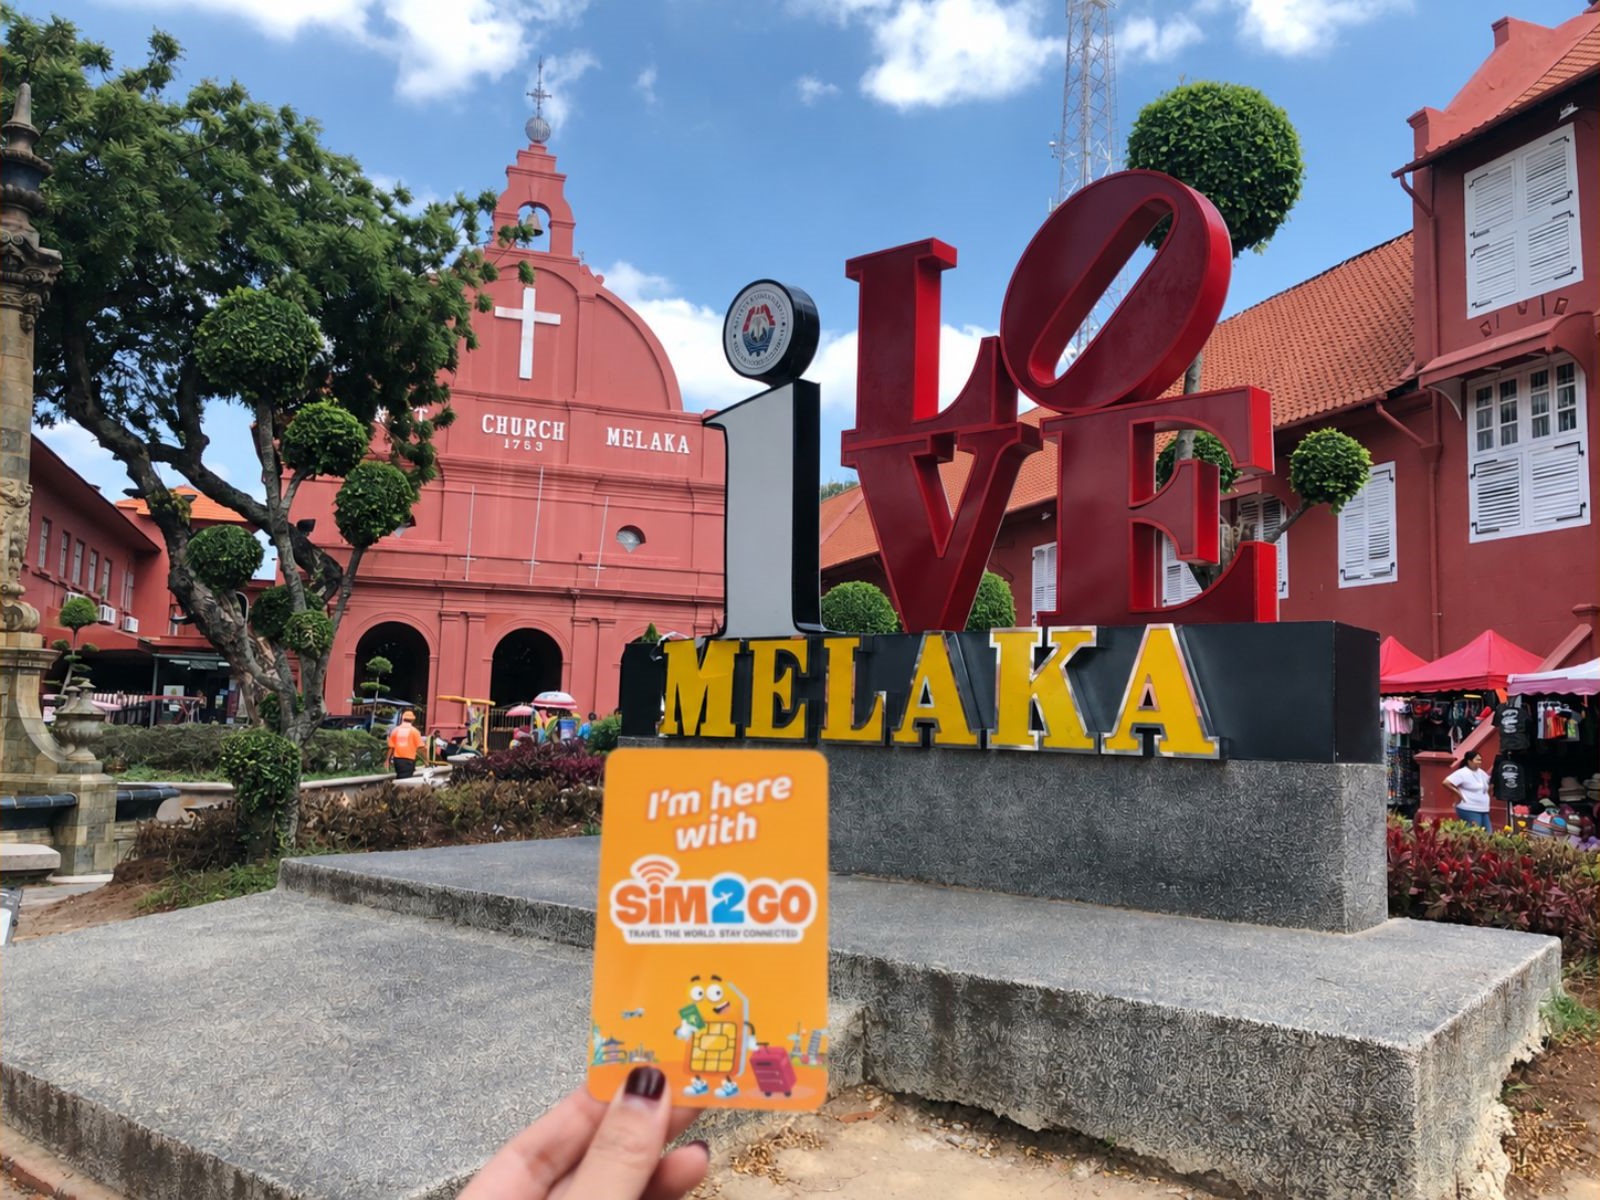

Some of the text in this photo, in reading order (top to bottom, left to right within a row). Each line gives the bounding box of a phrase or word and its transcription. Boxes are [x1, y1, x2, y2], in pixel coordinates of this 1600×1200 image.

[481, 413, 565, 441] CHURCH
[605, 426, 691, 454] MELAKA
[658, 623, 1223, 760] MELAKA
[647, 776, 792, 821] I'm here
[676, 811, 757, 851] with
[629, 928, 661, 938] TRAVEL
[664, 928, 680, 938] THE
[719, 928, 740, 938] STAY
[743, 928, 798, 938] CONNECTED
